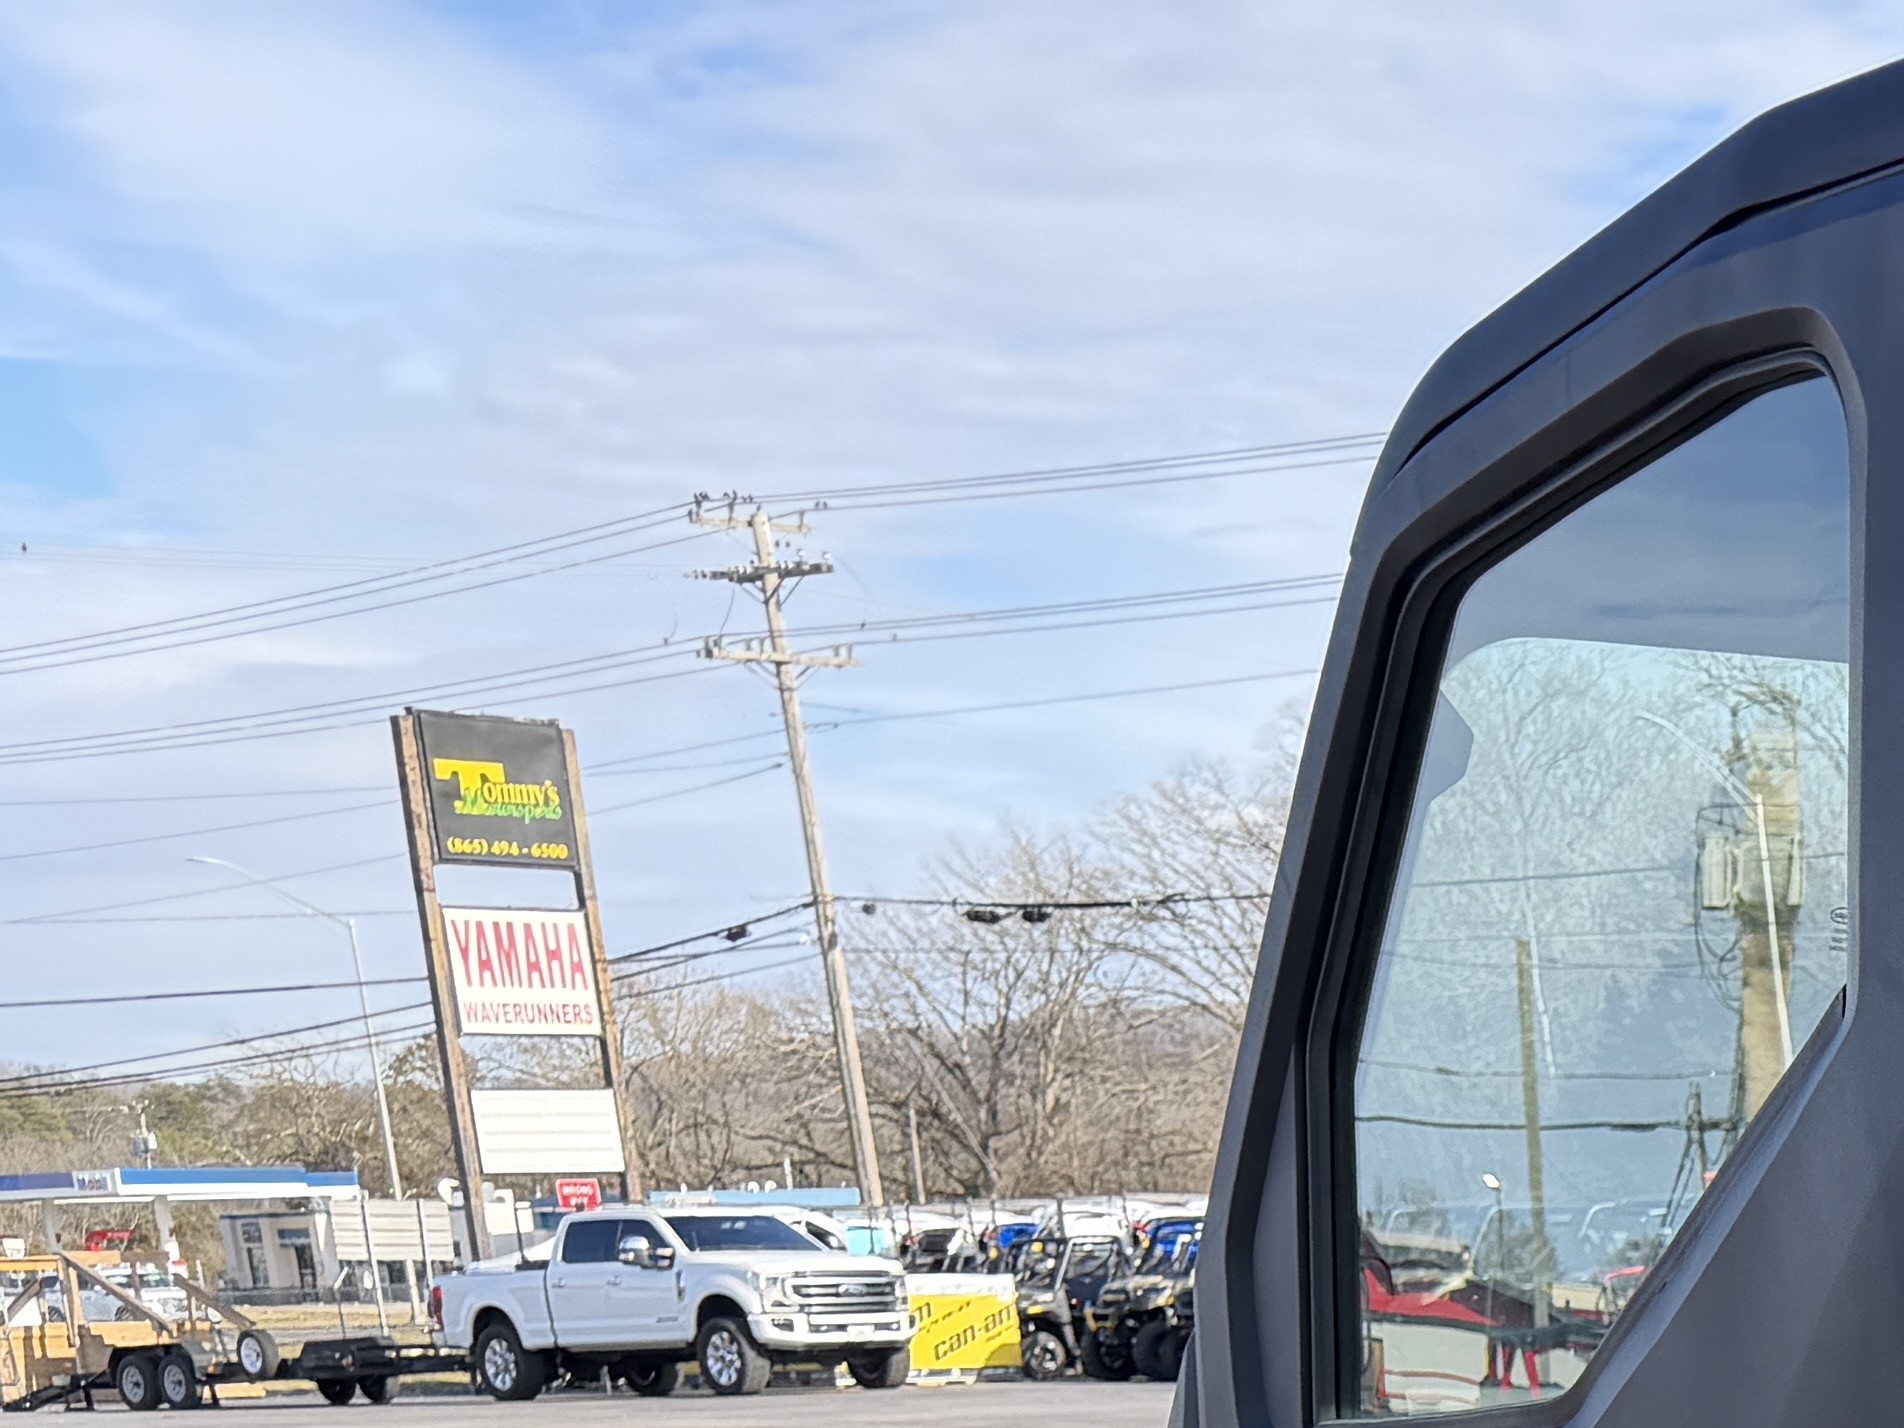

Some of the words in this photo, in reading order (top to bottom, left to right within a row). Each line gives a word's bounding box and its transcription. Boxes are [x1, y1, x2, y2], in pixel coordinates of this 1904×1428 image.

[433, 757, 560, 815] Tommy's
[447, 836, 489, 855] (865)
[491, 840, 519, 857] 494
[531, 843, 568, 860] 6500
[450, 919, 588, 991] YAMAHA
[463, 1002, 594, 1025] WAVERUNNERS
